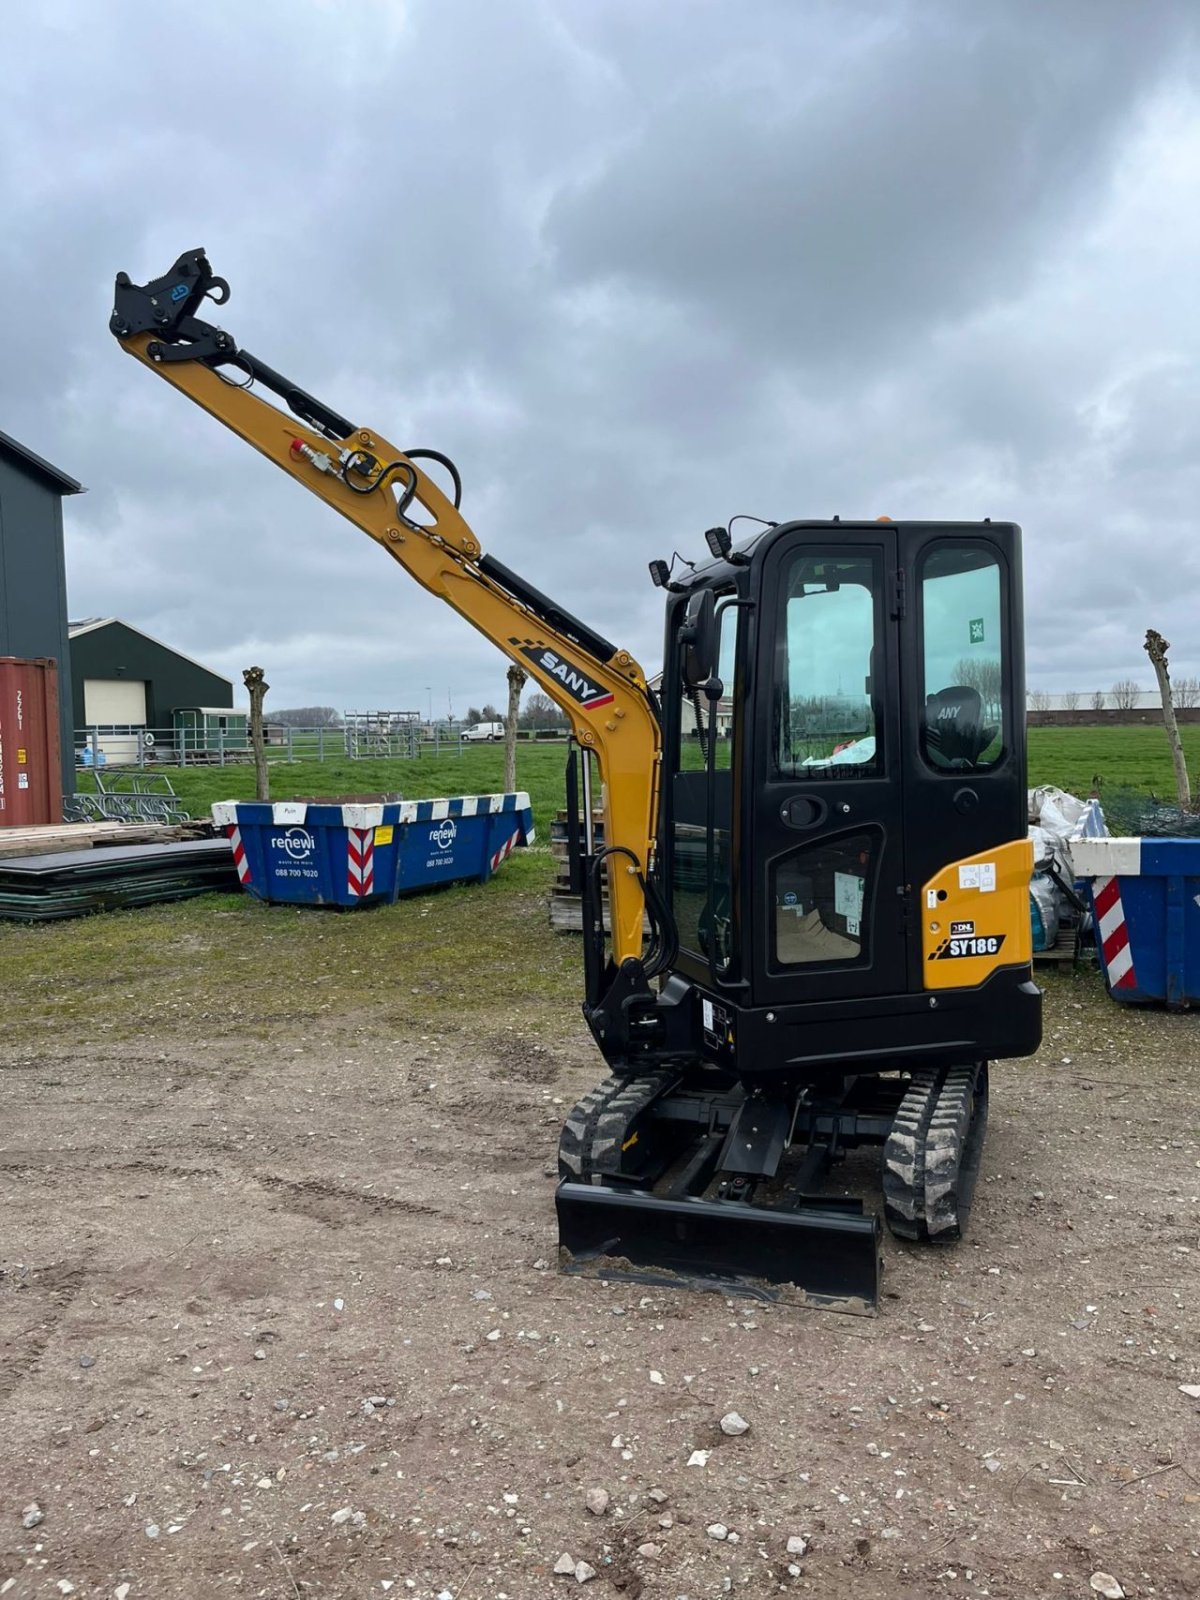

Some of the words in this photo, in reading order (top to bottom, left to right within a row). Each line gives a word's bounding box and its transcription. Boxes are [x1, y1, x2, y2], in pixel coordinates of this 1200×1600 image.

[540, 652, 597, 699] SANY
[275, 869, 288, 877] 088
[288, 869, 302, 877] 700
[302, 869, 319, 878] 3020
[950, 937, 997, 956] SY18C
